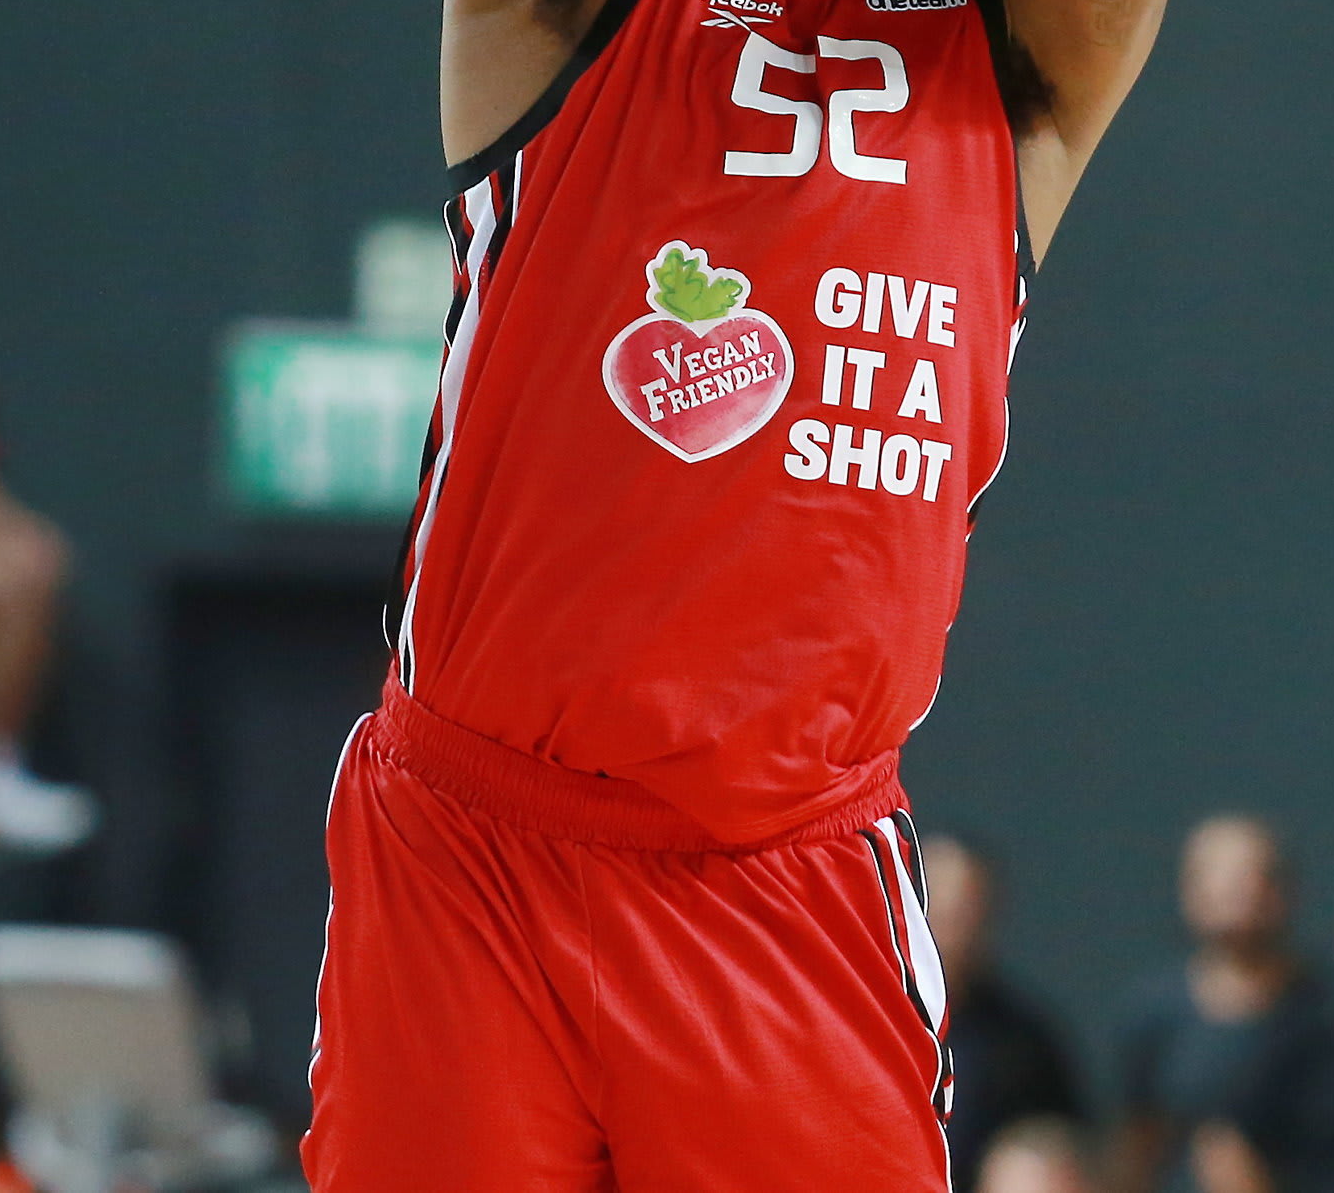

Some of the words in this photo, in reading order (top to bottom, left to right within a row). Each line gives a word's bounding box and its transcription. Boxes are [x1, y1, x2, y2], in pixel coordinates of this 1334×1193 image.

[724, 31, 910, 185] 52
[814, 267, 958, 348] GIVE
[640, 352, 777, 423] FRIENDLY
[652, 330, 762, 384] VEGAN
[821, 344, 886, 411] IT
[897, 359, 942, 424] A
[783, 418, 953, 503] SHOT
